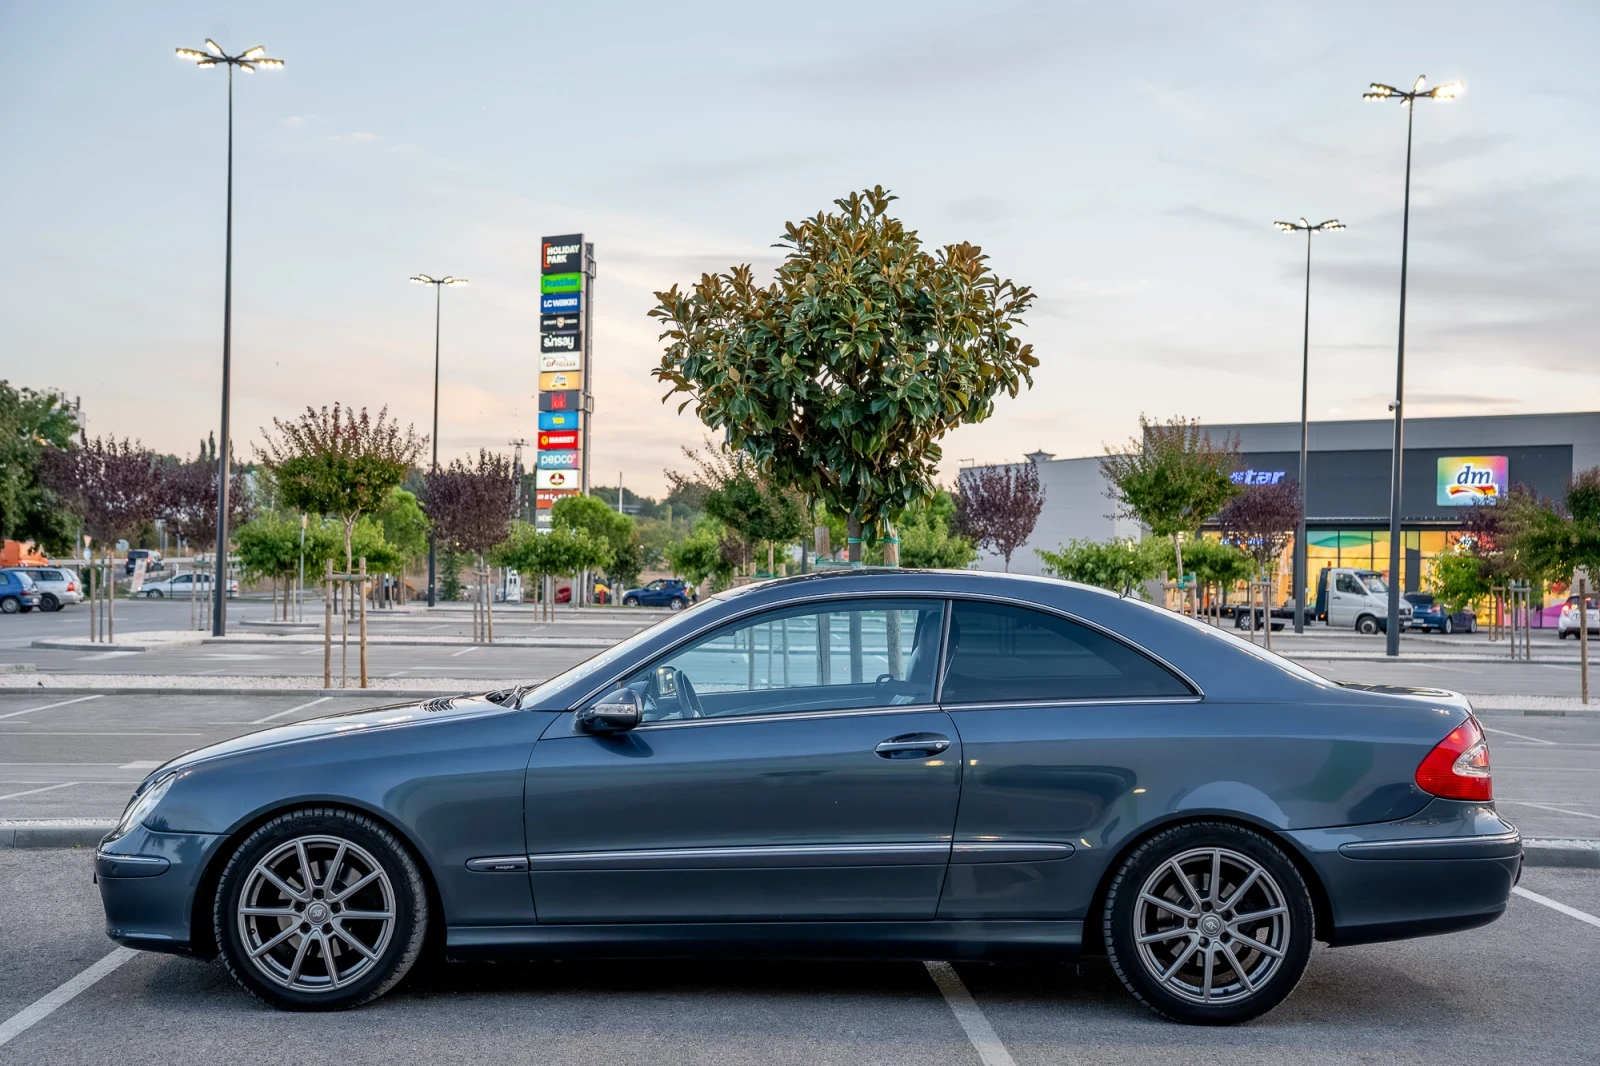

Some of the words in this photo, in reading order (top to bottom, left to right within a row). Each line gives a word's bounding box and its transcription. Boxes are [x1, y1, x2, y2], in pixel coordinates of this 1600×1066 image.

[547, 244, 580, 255] HOLIDAY
[546, 254, 567, 264] PARK
[543, 300, 552, 308] LC
[554, 375, 566, 383] dm
[541, 454, 574, 466] pepco
[1457, 465, 1491, 485] dm
